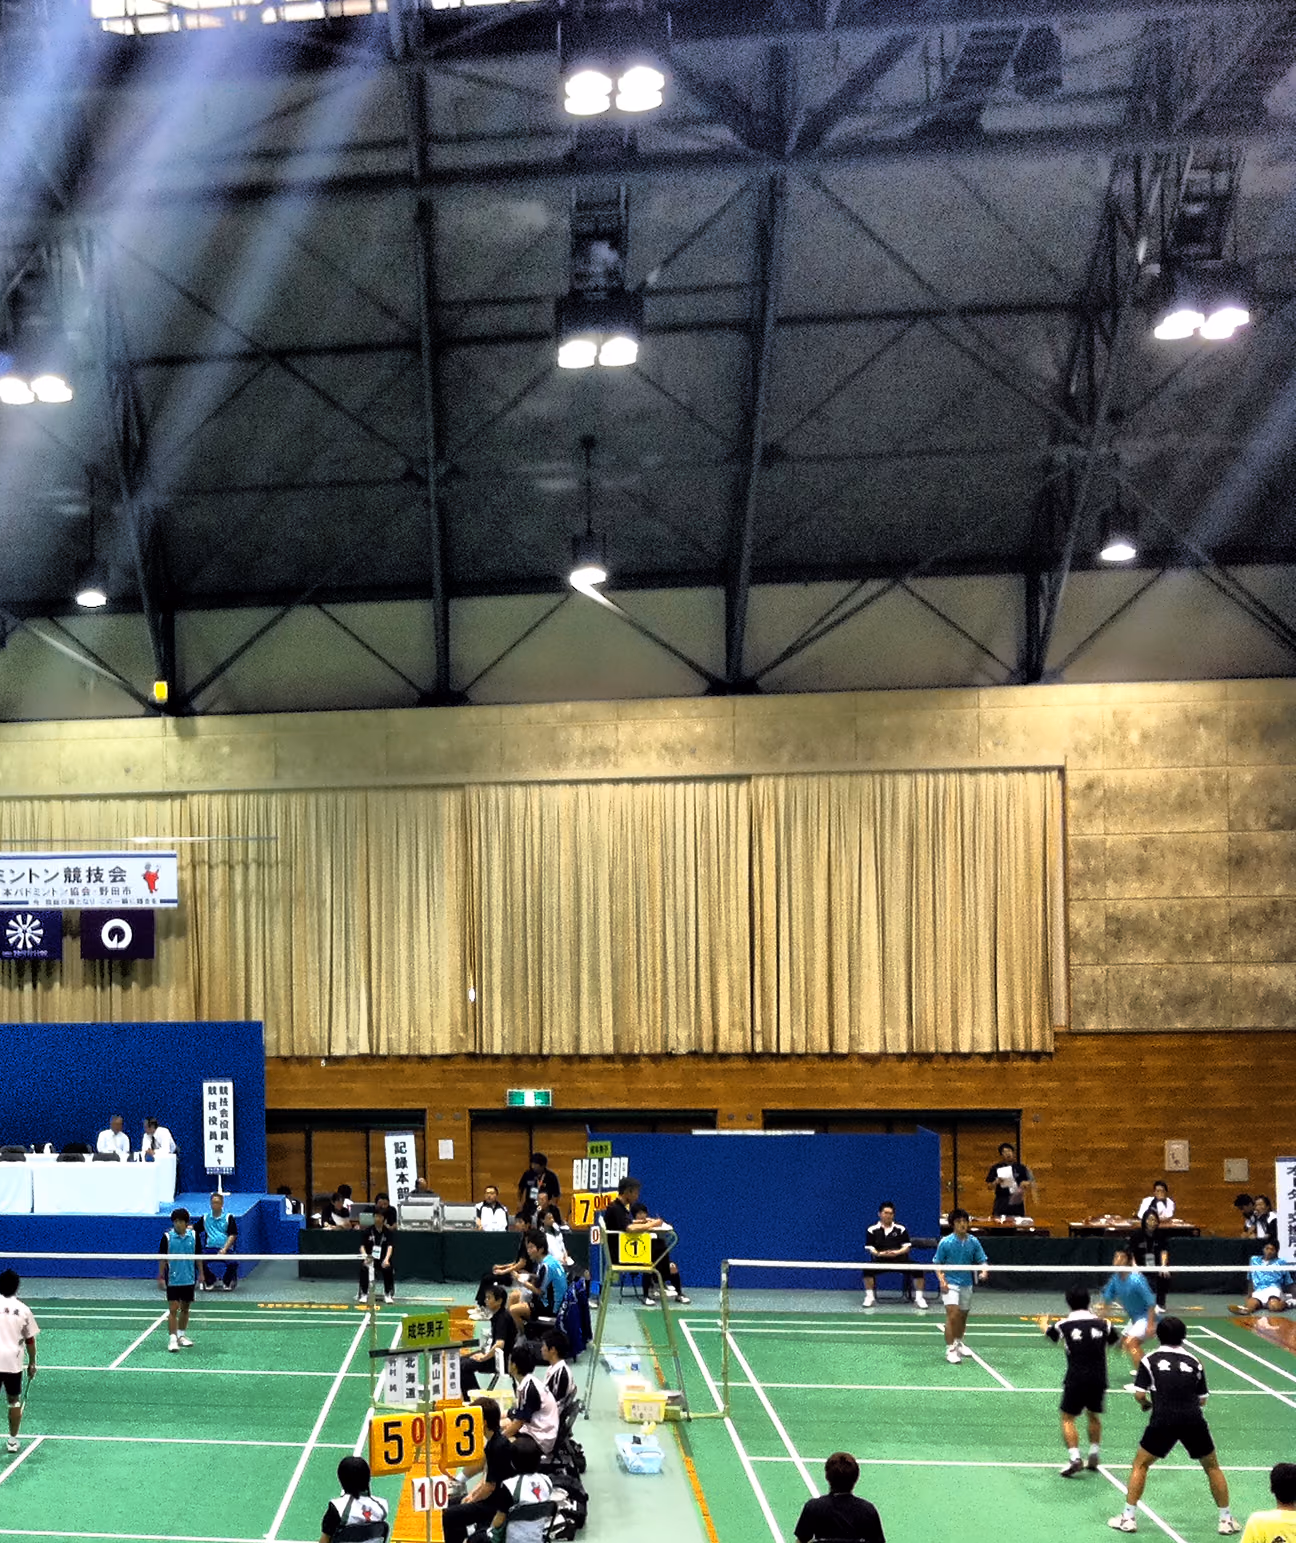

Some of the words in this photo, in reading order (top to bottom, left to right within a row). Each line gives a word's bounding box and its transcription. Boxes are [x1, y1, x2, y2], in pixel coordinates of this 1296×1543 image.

[394, 1141, 410, 1219] 記録本部
[580, 1200, 590, 1223] 7
[407, 1320, 444, 1339] 成年男子
[405, 1356, 416, 1399] 北海道
[383, 1421, 404, 1466] 5
[455, 1413, 475, 1457] 3
